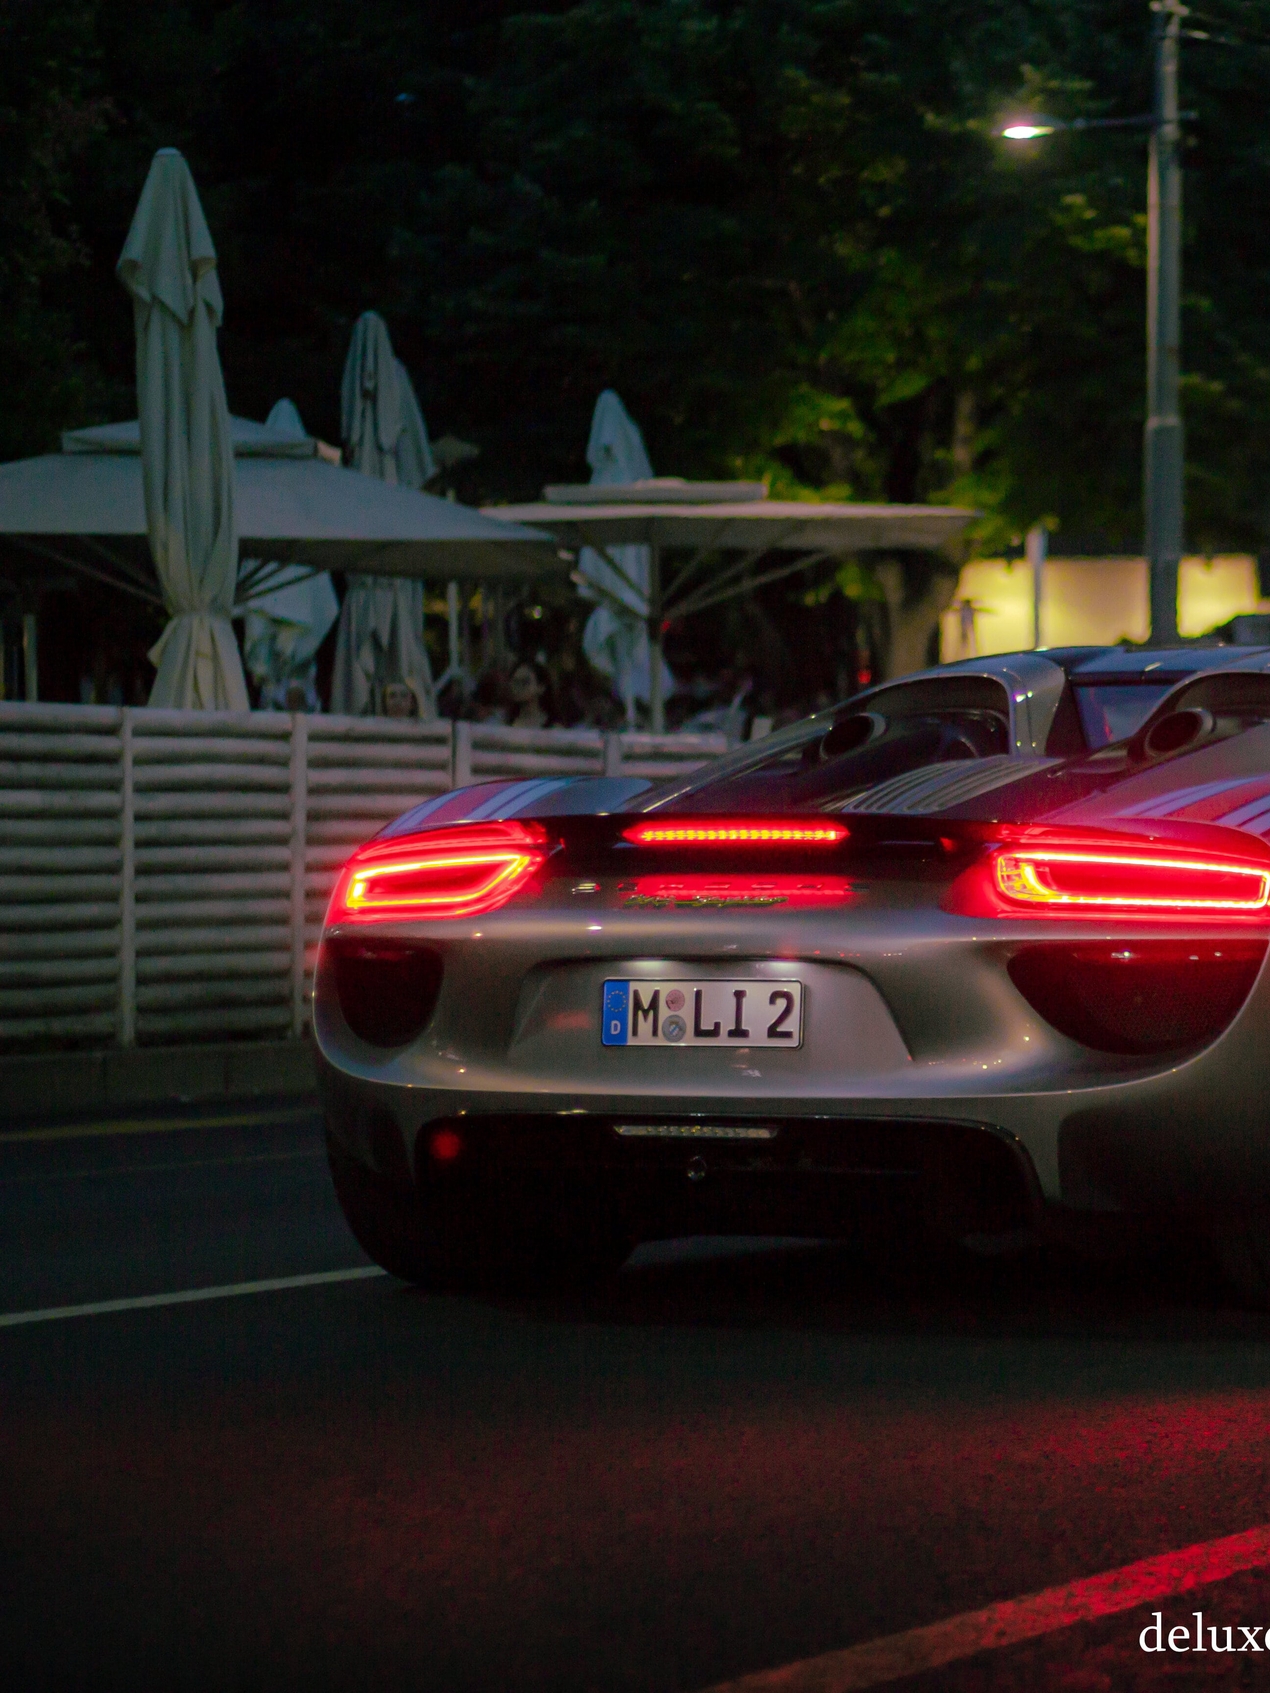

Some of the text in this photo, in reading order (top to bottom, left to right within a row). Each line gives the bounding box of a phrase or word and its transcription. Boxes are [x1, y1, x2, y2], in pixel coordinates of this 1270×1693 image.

[610, 1019, 622, 1036] D
[631, 988, 795, 1039] M LI 2
